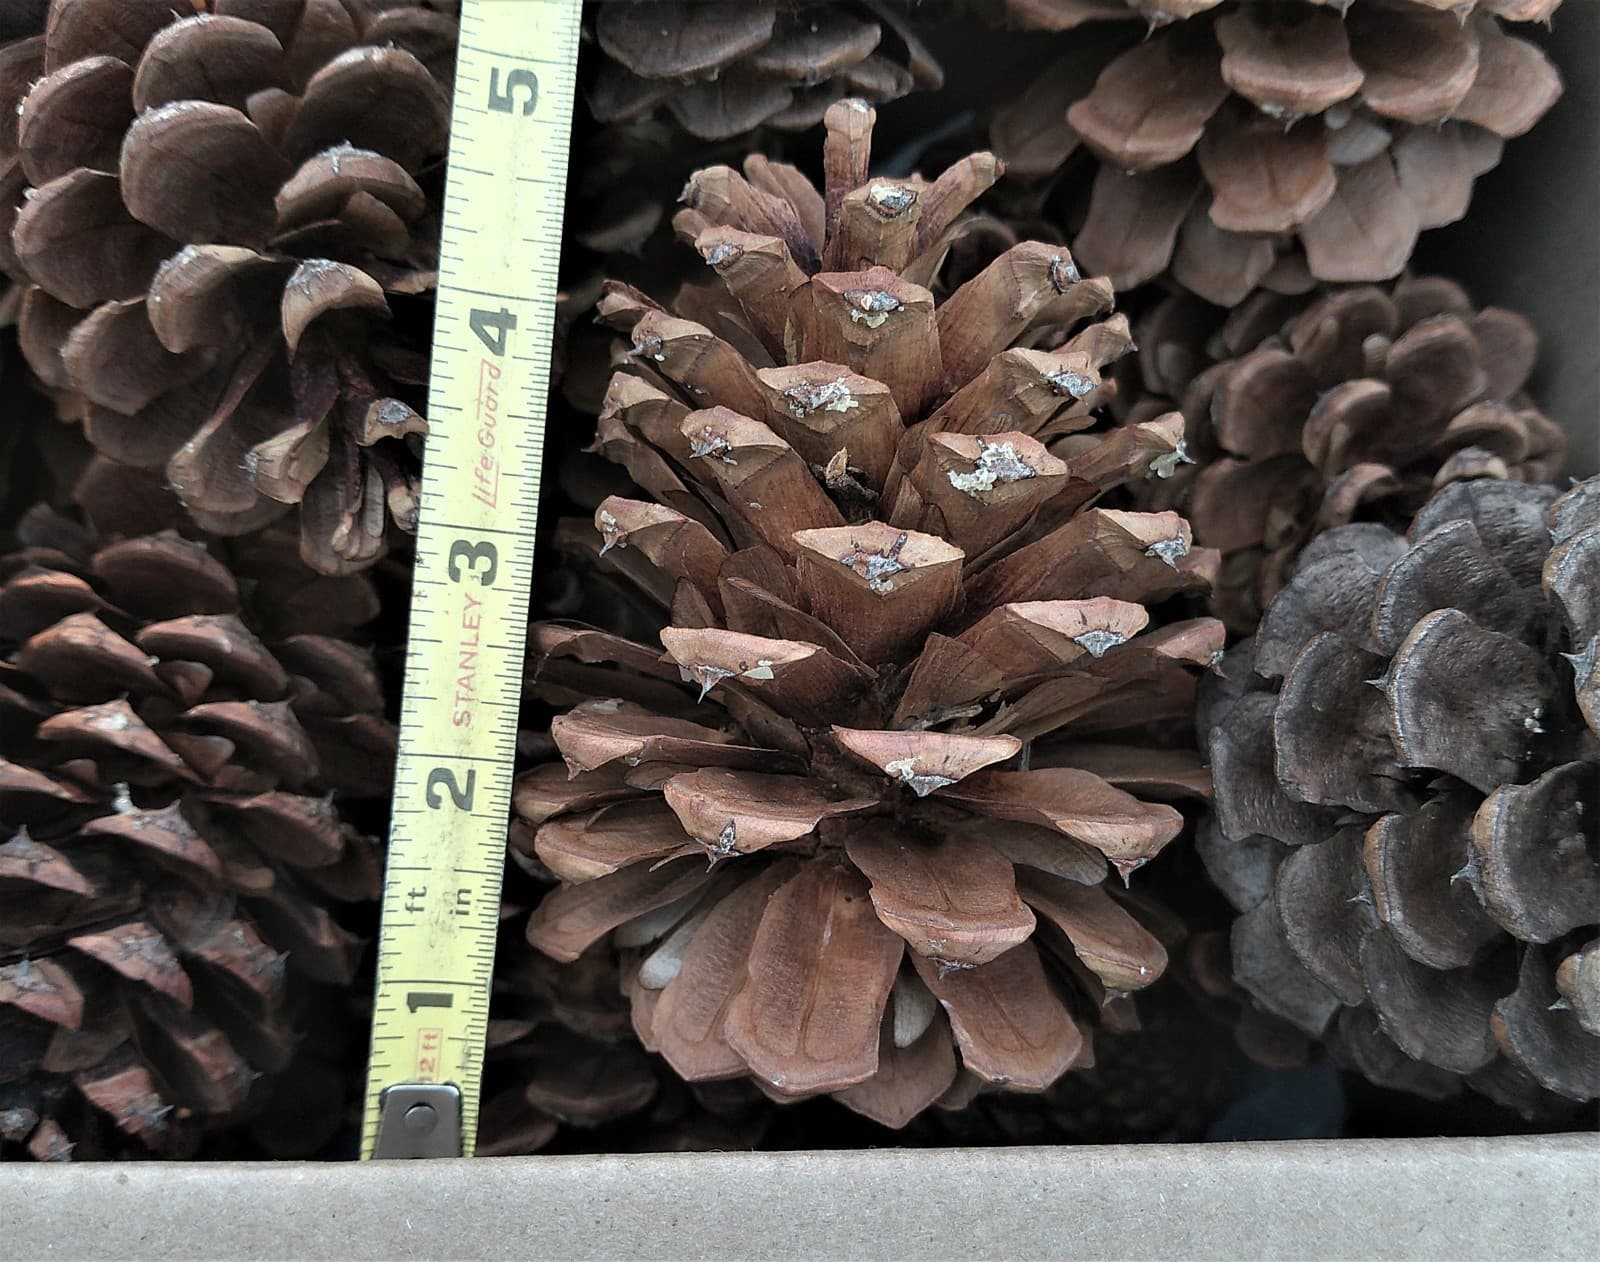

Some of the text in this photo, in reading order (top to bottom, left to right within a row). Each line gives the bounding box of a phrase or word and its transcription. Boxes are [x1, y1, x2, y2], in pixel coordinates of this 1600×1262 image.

[488, 66, 539, 117] 5
[469, 307, 518, 357] 4
[448, 539, 498, 587] 3
[453, 592, 483, 728] STANLEY
[425, 767, 476, 812] 2
[405, 885, 428, 914] ft
[449, 887, 473, 916] in
[406, 991, 454, 1013] 1
